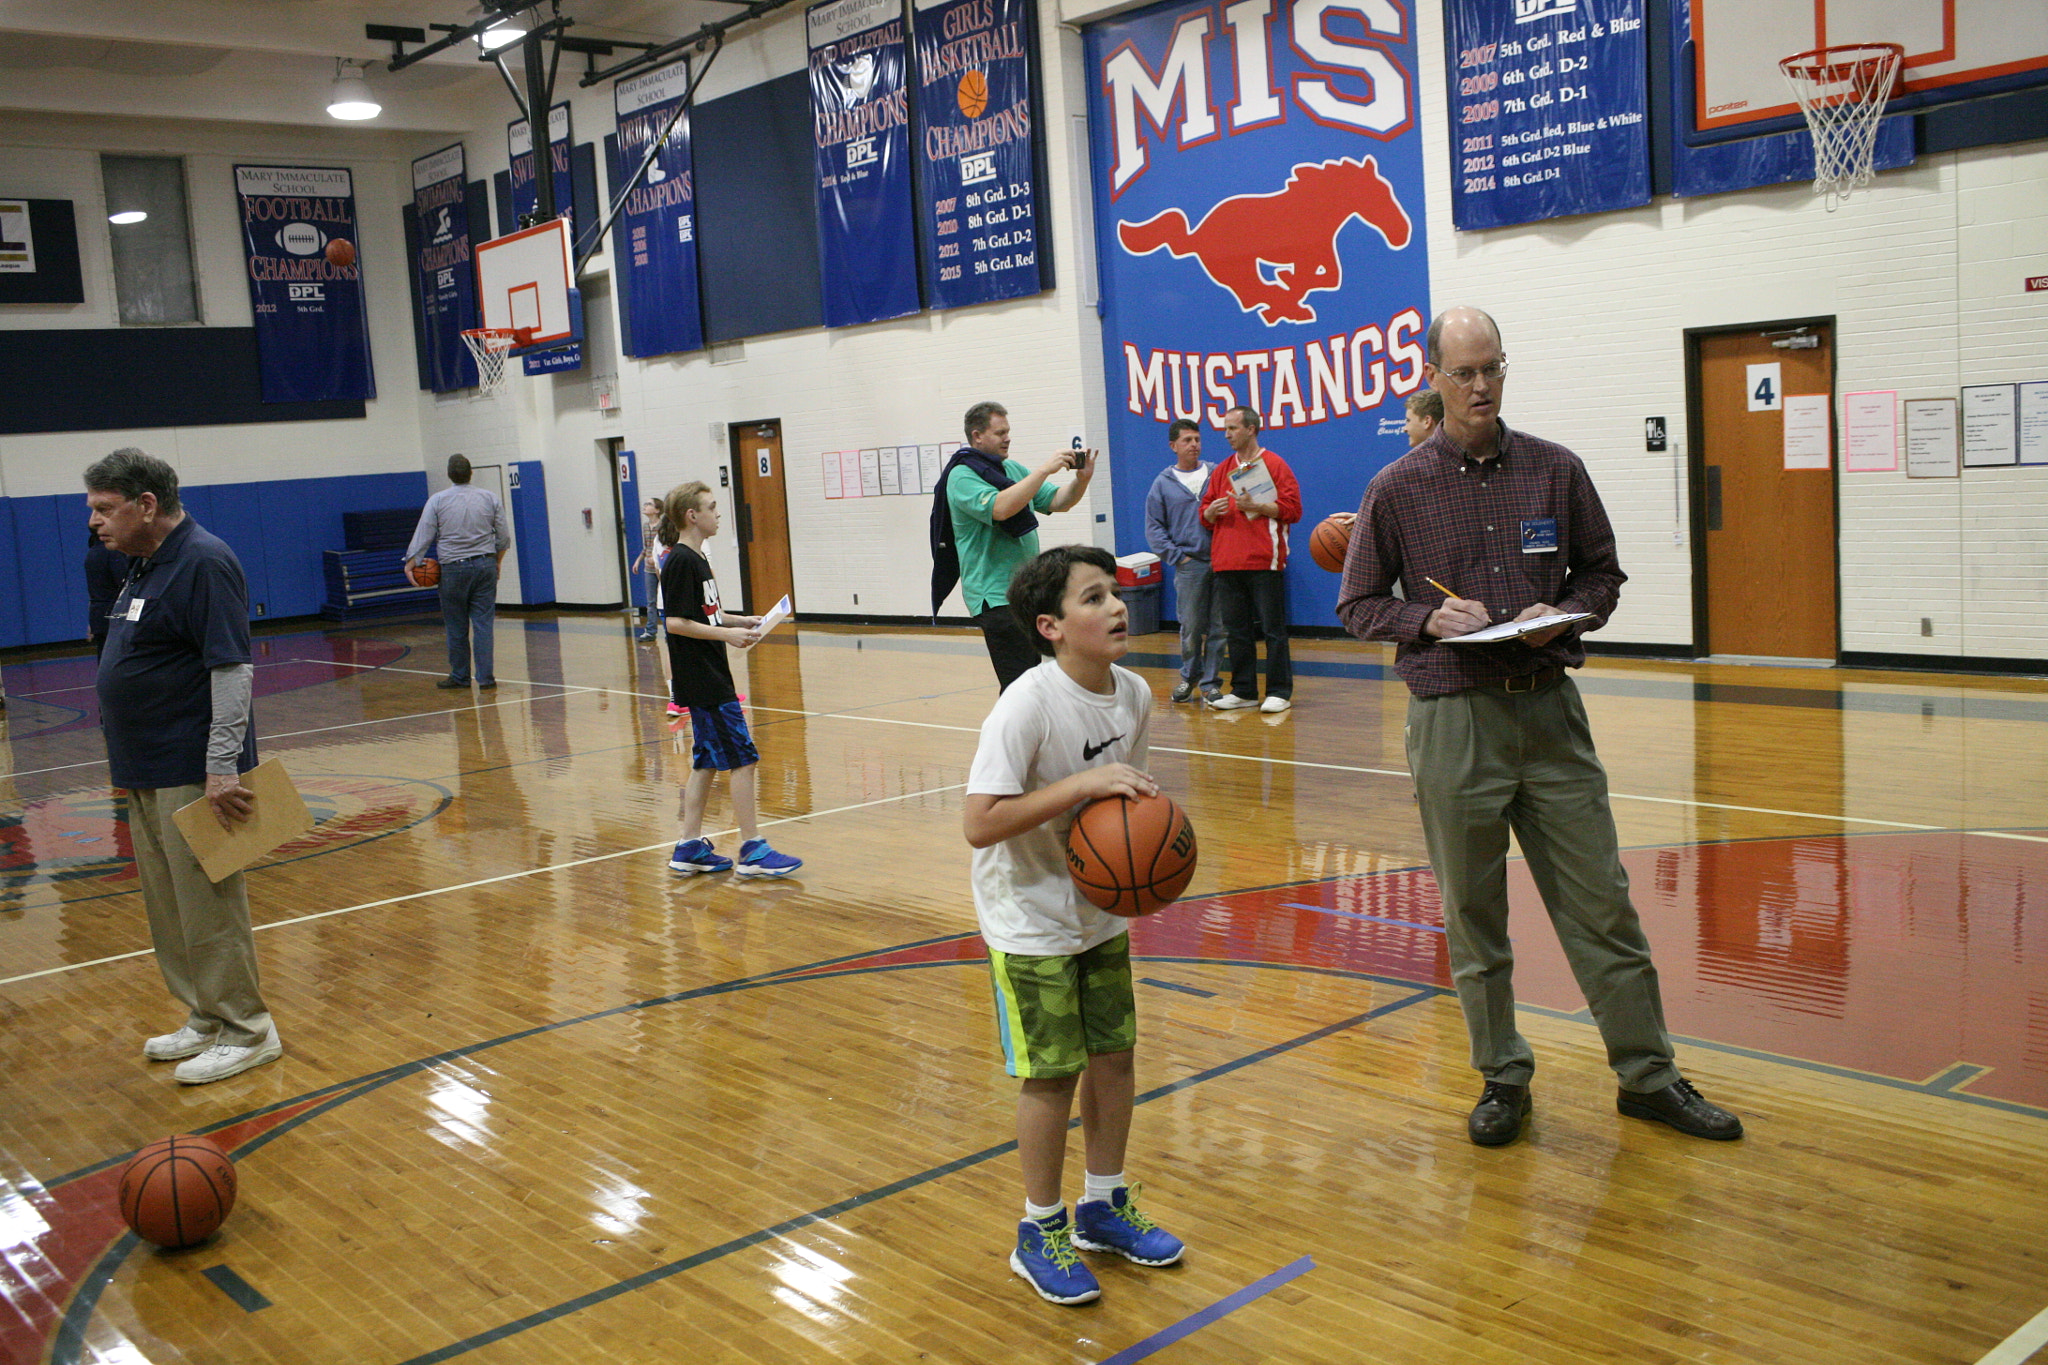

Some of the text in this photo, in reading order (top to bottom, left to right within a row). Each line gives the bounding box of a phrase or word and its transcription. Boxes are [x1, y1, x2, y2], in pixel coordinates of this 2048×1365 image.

[811, 9, 837, 28] MARY
[836, 13, 873, 35] SCHOOL
[944, 0, 994, 40] GIRLS
[920, 22, 1024, 87] BASKETBALL
[1460, 17, 1641, 68] 2007 5th Grd. Red & Blue
[619, 64, 684, 95] MARY IMMACULATE
[1461, 56, 1588, 96] 2009 6th Grd. D-2
[637, 88, 665, 106] SCHOOL
[1102, 0, 1414, 204] MIS
[1462, 86, 1588, 124] 2009 7th Grd. D-1
[814, 86, 908, 148] CHAMPIONS
[926, 99, 1030, 160] CHAMPIONS
[1463, 134, 1494, 153] 2011
[1502, 134, 1518, 148] 5th
[1520, 130, 1543, 144] Grd.
[1568, 118, 1594, 133] Blue
[1597, 118, 1608, 130] &
[1610, 112, 1642, 128] White
[847, 142, 878, 164] DPL
[1464, 141, 1591, 173] 2012 6th Grd. D-2 Blue
[242, 171, 345, 183] MARY IMMACULATE
[961, 157, 996, 180] DPL
[1464, 168, 1560, 194] 2014 8th Grd. D-1
[273, 184, 317, 194] SCHOOL
[625, 170, 692, 216] CHAMPIONS
[966, 192, 981, 208] 8th
[984, 187, 1006, 203] Grd.
[1010, 182, 1030, 198] D-3
[243, 197, 352, 224] FOOTBALL
[968, 213, 982, 229] 8th
[986, 208, 1008, 225] Grd.
[1012, 204, 1032, 220] D-1
[939, 229, 1032, 258] 2012 7th Grd. D-2
[250, 256, 358, 281] CHAMPIONS
[437, 271, 454, 287] DPL
[940, 251, 1034, 281] 2015 5th Grd. Red
[289, 285, 325, 298] DPL
[2030, 278, 2048, 289] VIS
[1123, 306, 1427, 430] MUSTANGS
[1754, 377, 1775, 406] 4
[1072, 436, 1082, 450] 6
[621, 464, 628, 479] 9
[760, 457, 768, 474] 8
[510, 472, 520, 487] 10
